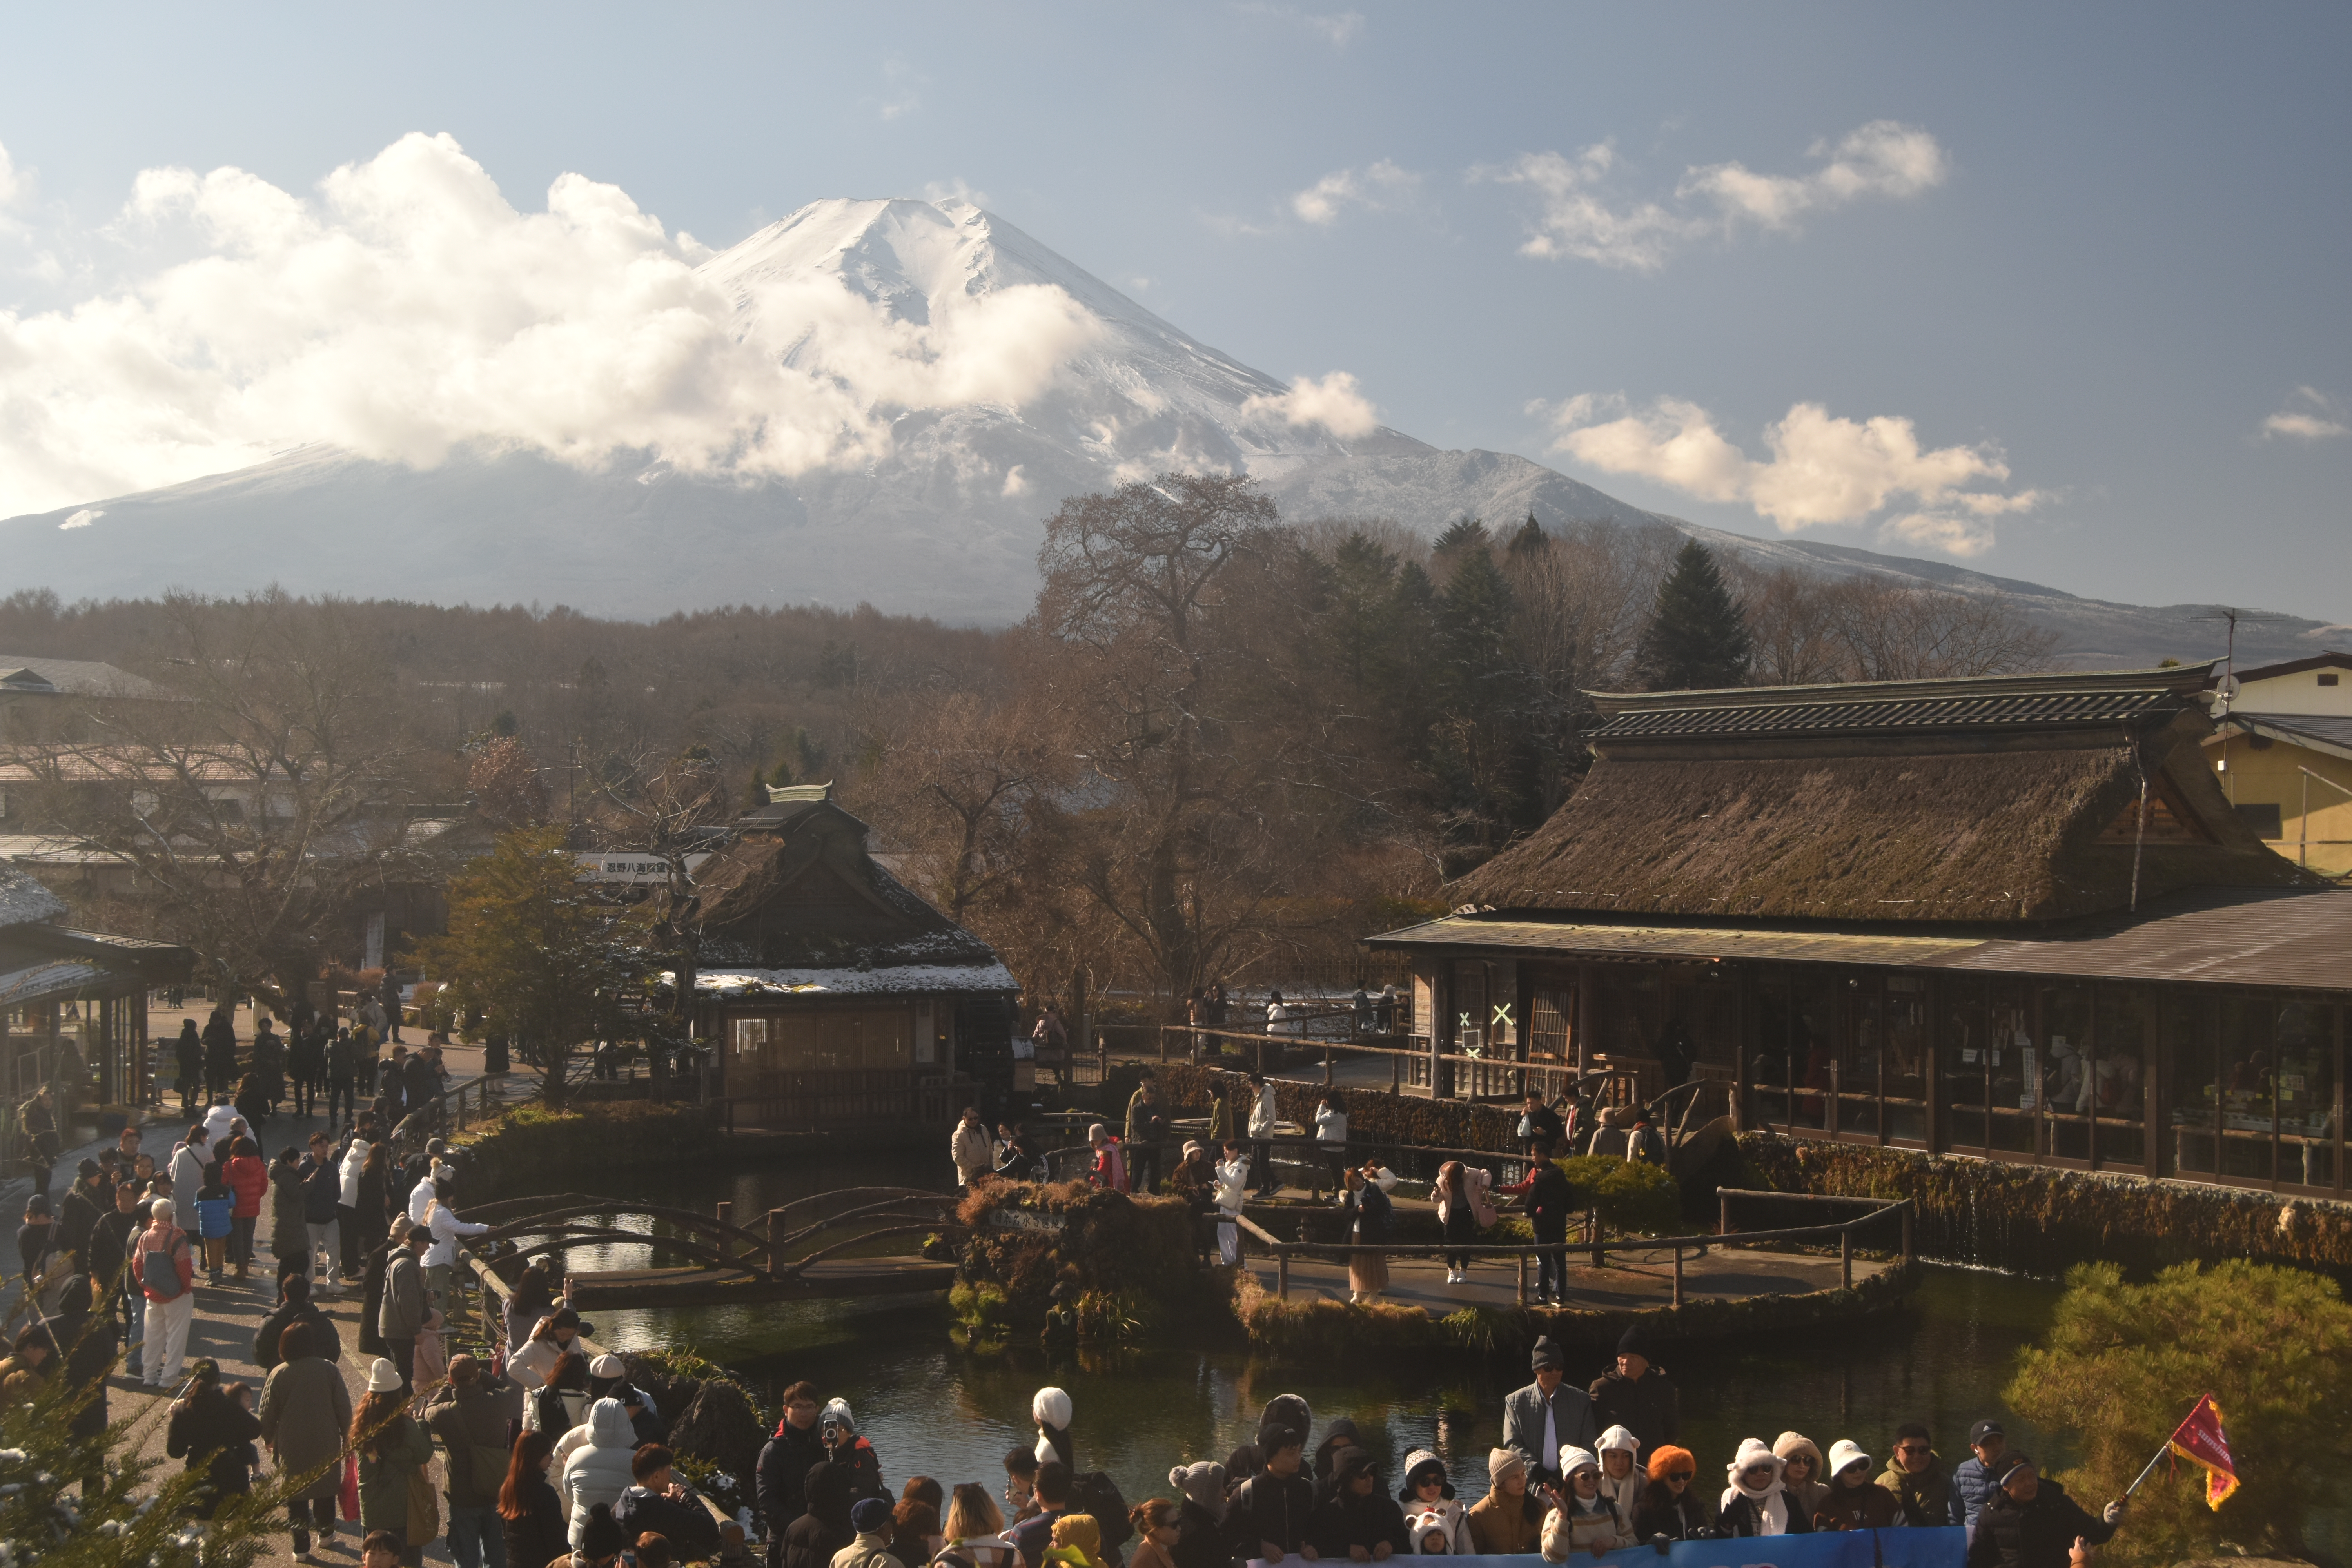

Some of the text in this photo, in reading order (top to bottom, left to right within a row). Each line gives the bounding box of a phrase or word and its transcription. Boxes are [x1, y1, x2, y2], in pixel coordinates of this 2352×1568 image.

[607, 862, 672, 873] 忍野八海展望
